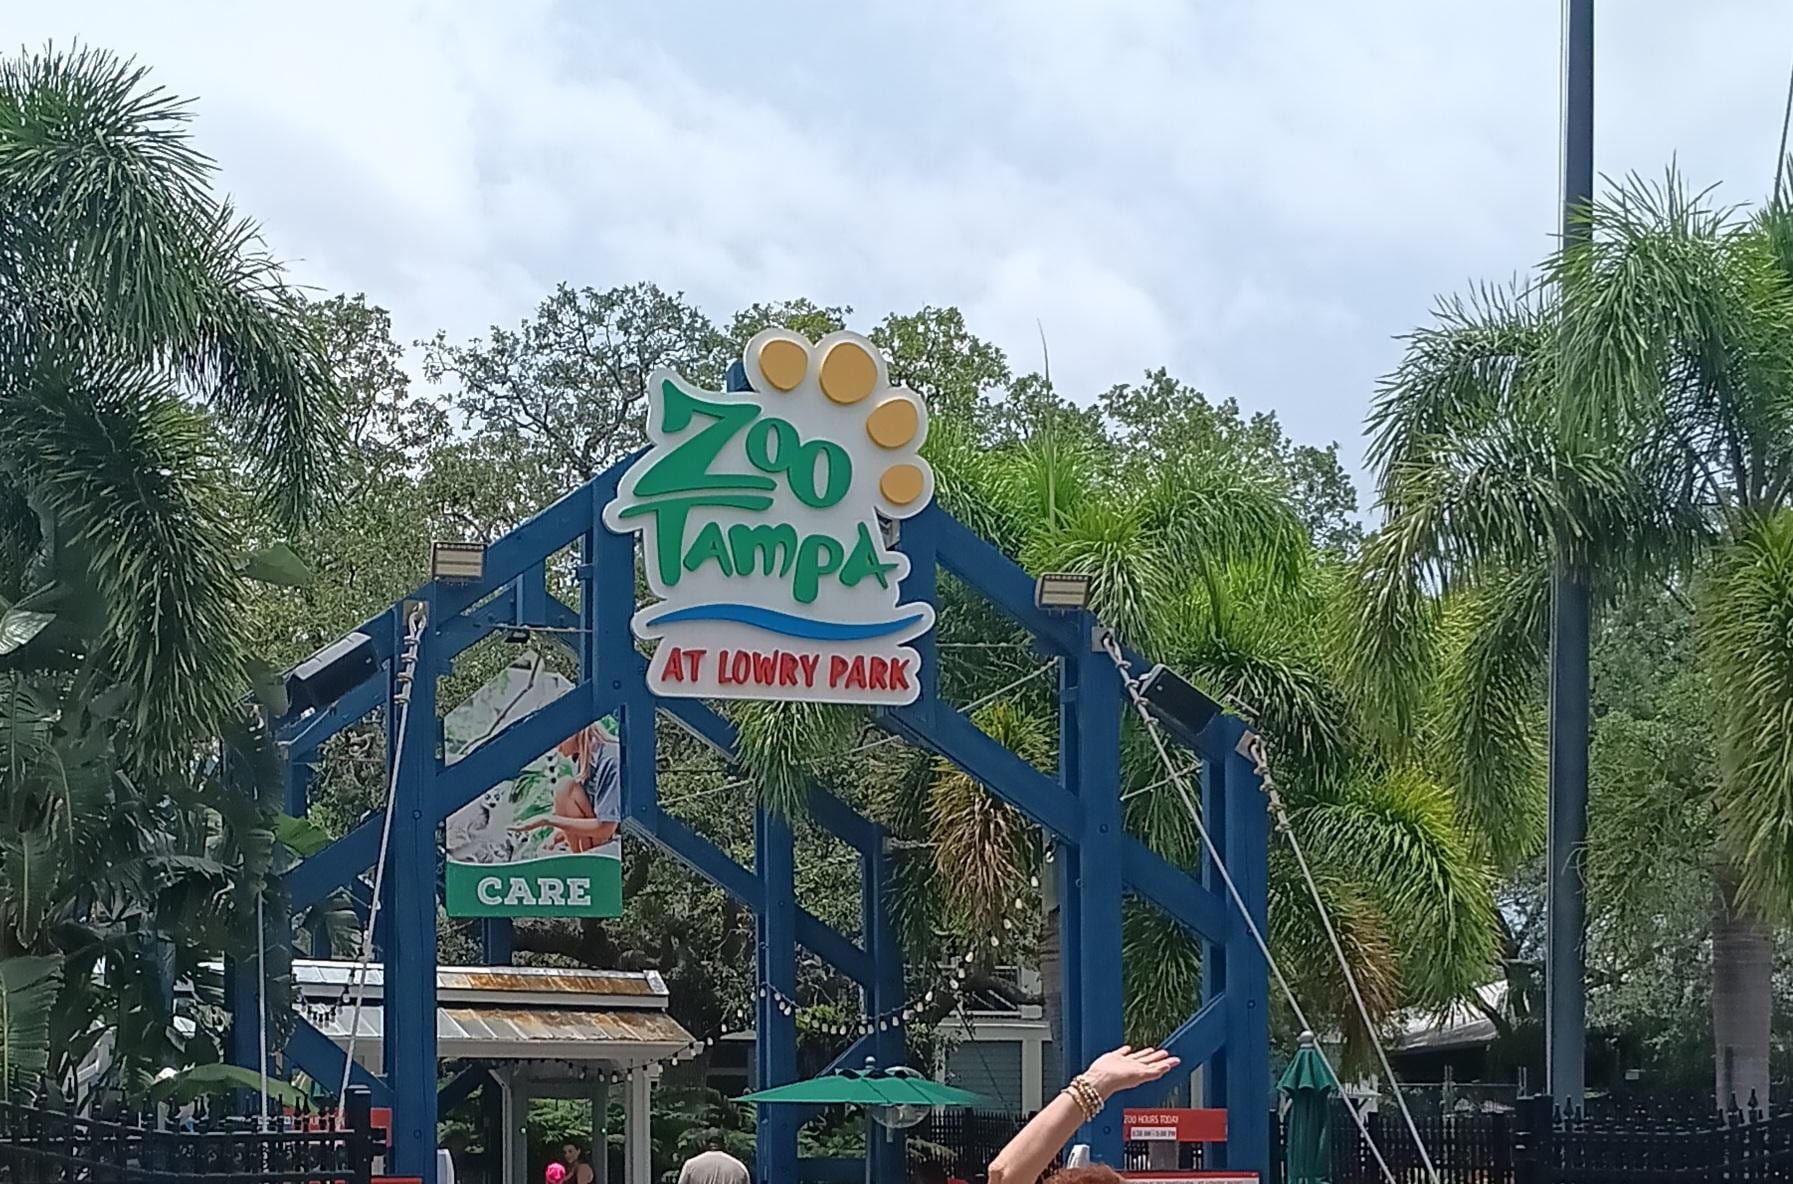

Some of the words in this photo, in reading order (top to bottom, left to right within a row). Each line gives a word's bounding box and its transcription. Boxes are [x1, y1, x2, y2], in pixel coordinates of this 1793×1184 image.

[633, 378, 853, 509] Zoo
[661, 647, 707, 684] AT
[717, 649, 820, 687] LOWRY
[829, 655, 910, 691] PARK
[477, 877, 592, 906] CARE
[1138, 1115, 1159, 1124] HOURS
[1160, 1115, 1179, 1124] TODAY
